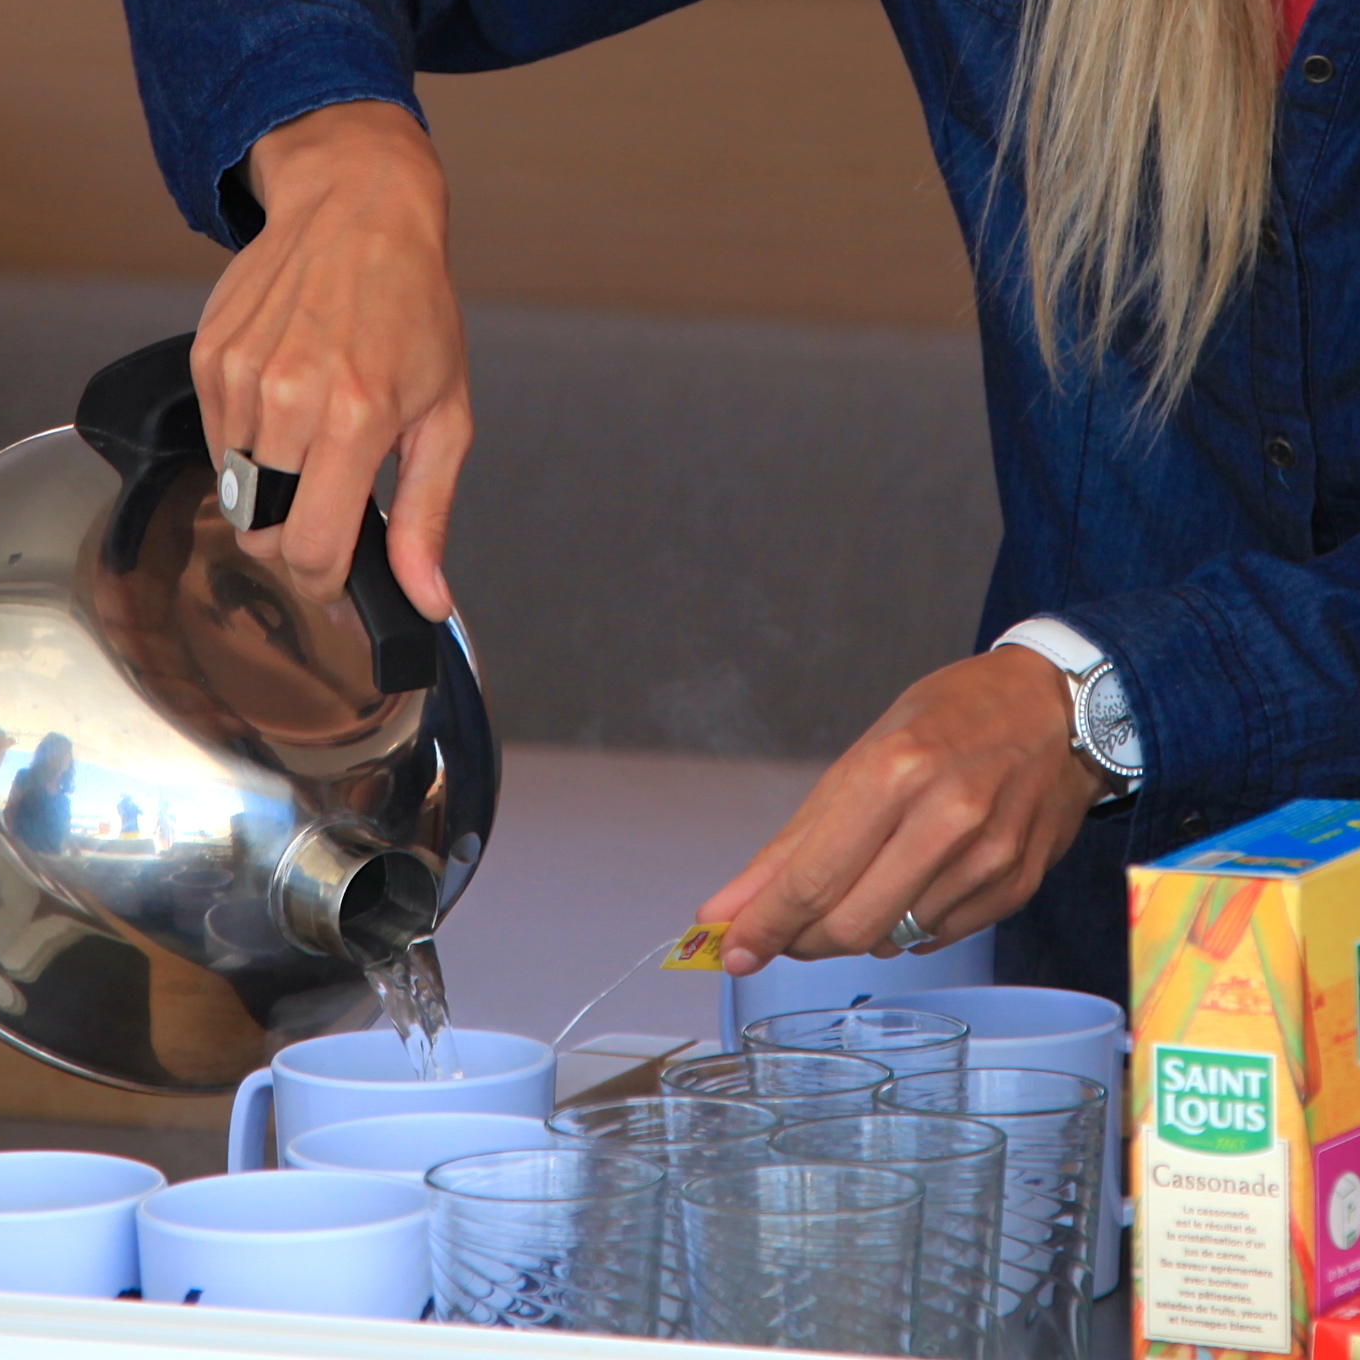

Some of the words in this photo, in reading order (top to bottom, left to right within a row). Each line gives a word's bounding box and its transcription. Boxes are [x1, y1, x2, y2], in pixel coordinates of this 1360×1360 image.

[1163, 1059, 1268, 1099] SAINT
[1163, 1095, 1267, 1136] LOUIS
[1152, 1164, 1281, 1199] Cassonade
[1197, 1207, 1250, 1220] cassonade
[1184, 1276, 1206, 1286] avec
[1208, 1276, 1249, 1290] bonheur
[1156, 1301, 1194, 1313] salades
[1181, 1316, 1228, 1331] fromages
